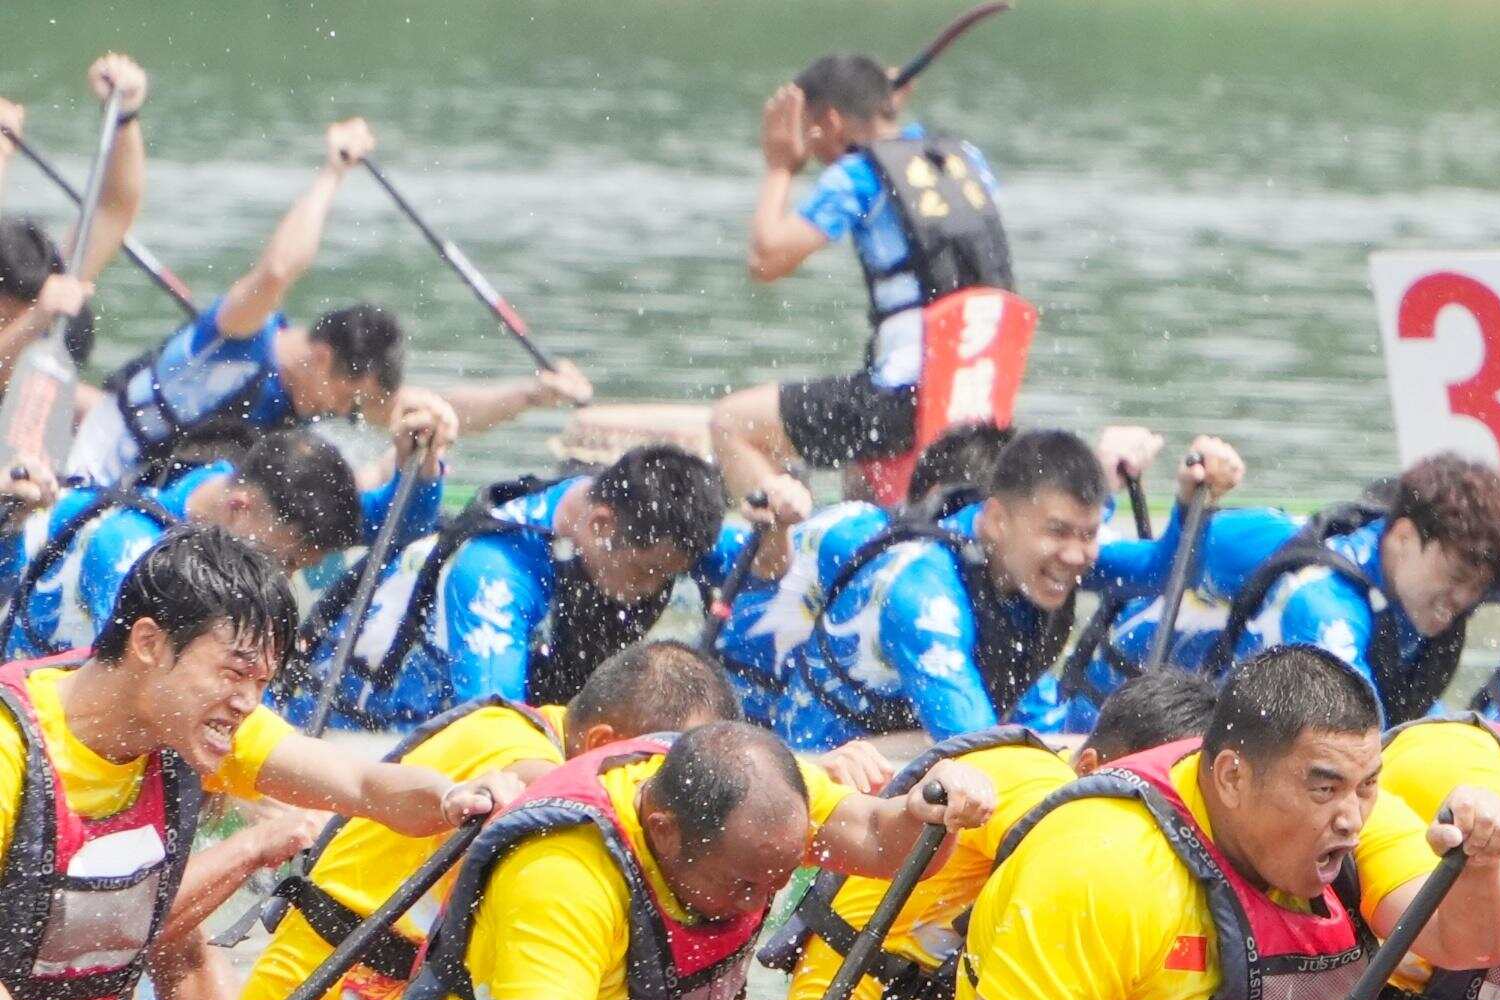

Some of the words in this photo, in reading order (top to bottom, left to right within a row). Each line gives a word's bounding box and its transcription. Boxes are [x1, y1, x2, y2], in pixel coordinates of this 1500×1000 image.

[1180, 826, 1200, 848] GO
[1246, 937, 1258, 962] GO
[1298, 956, 1340, 971] JUST
[1341, 948, 1361, 965] GO
